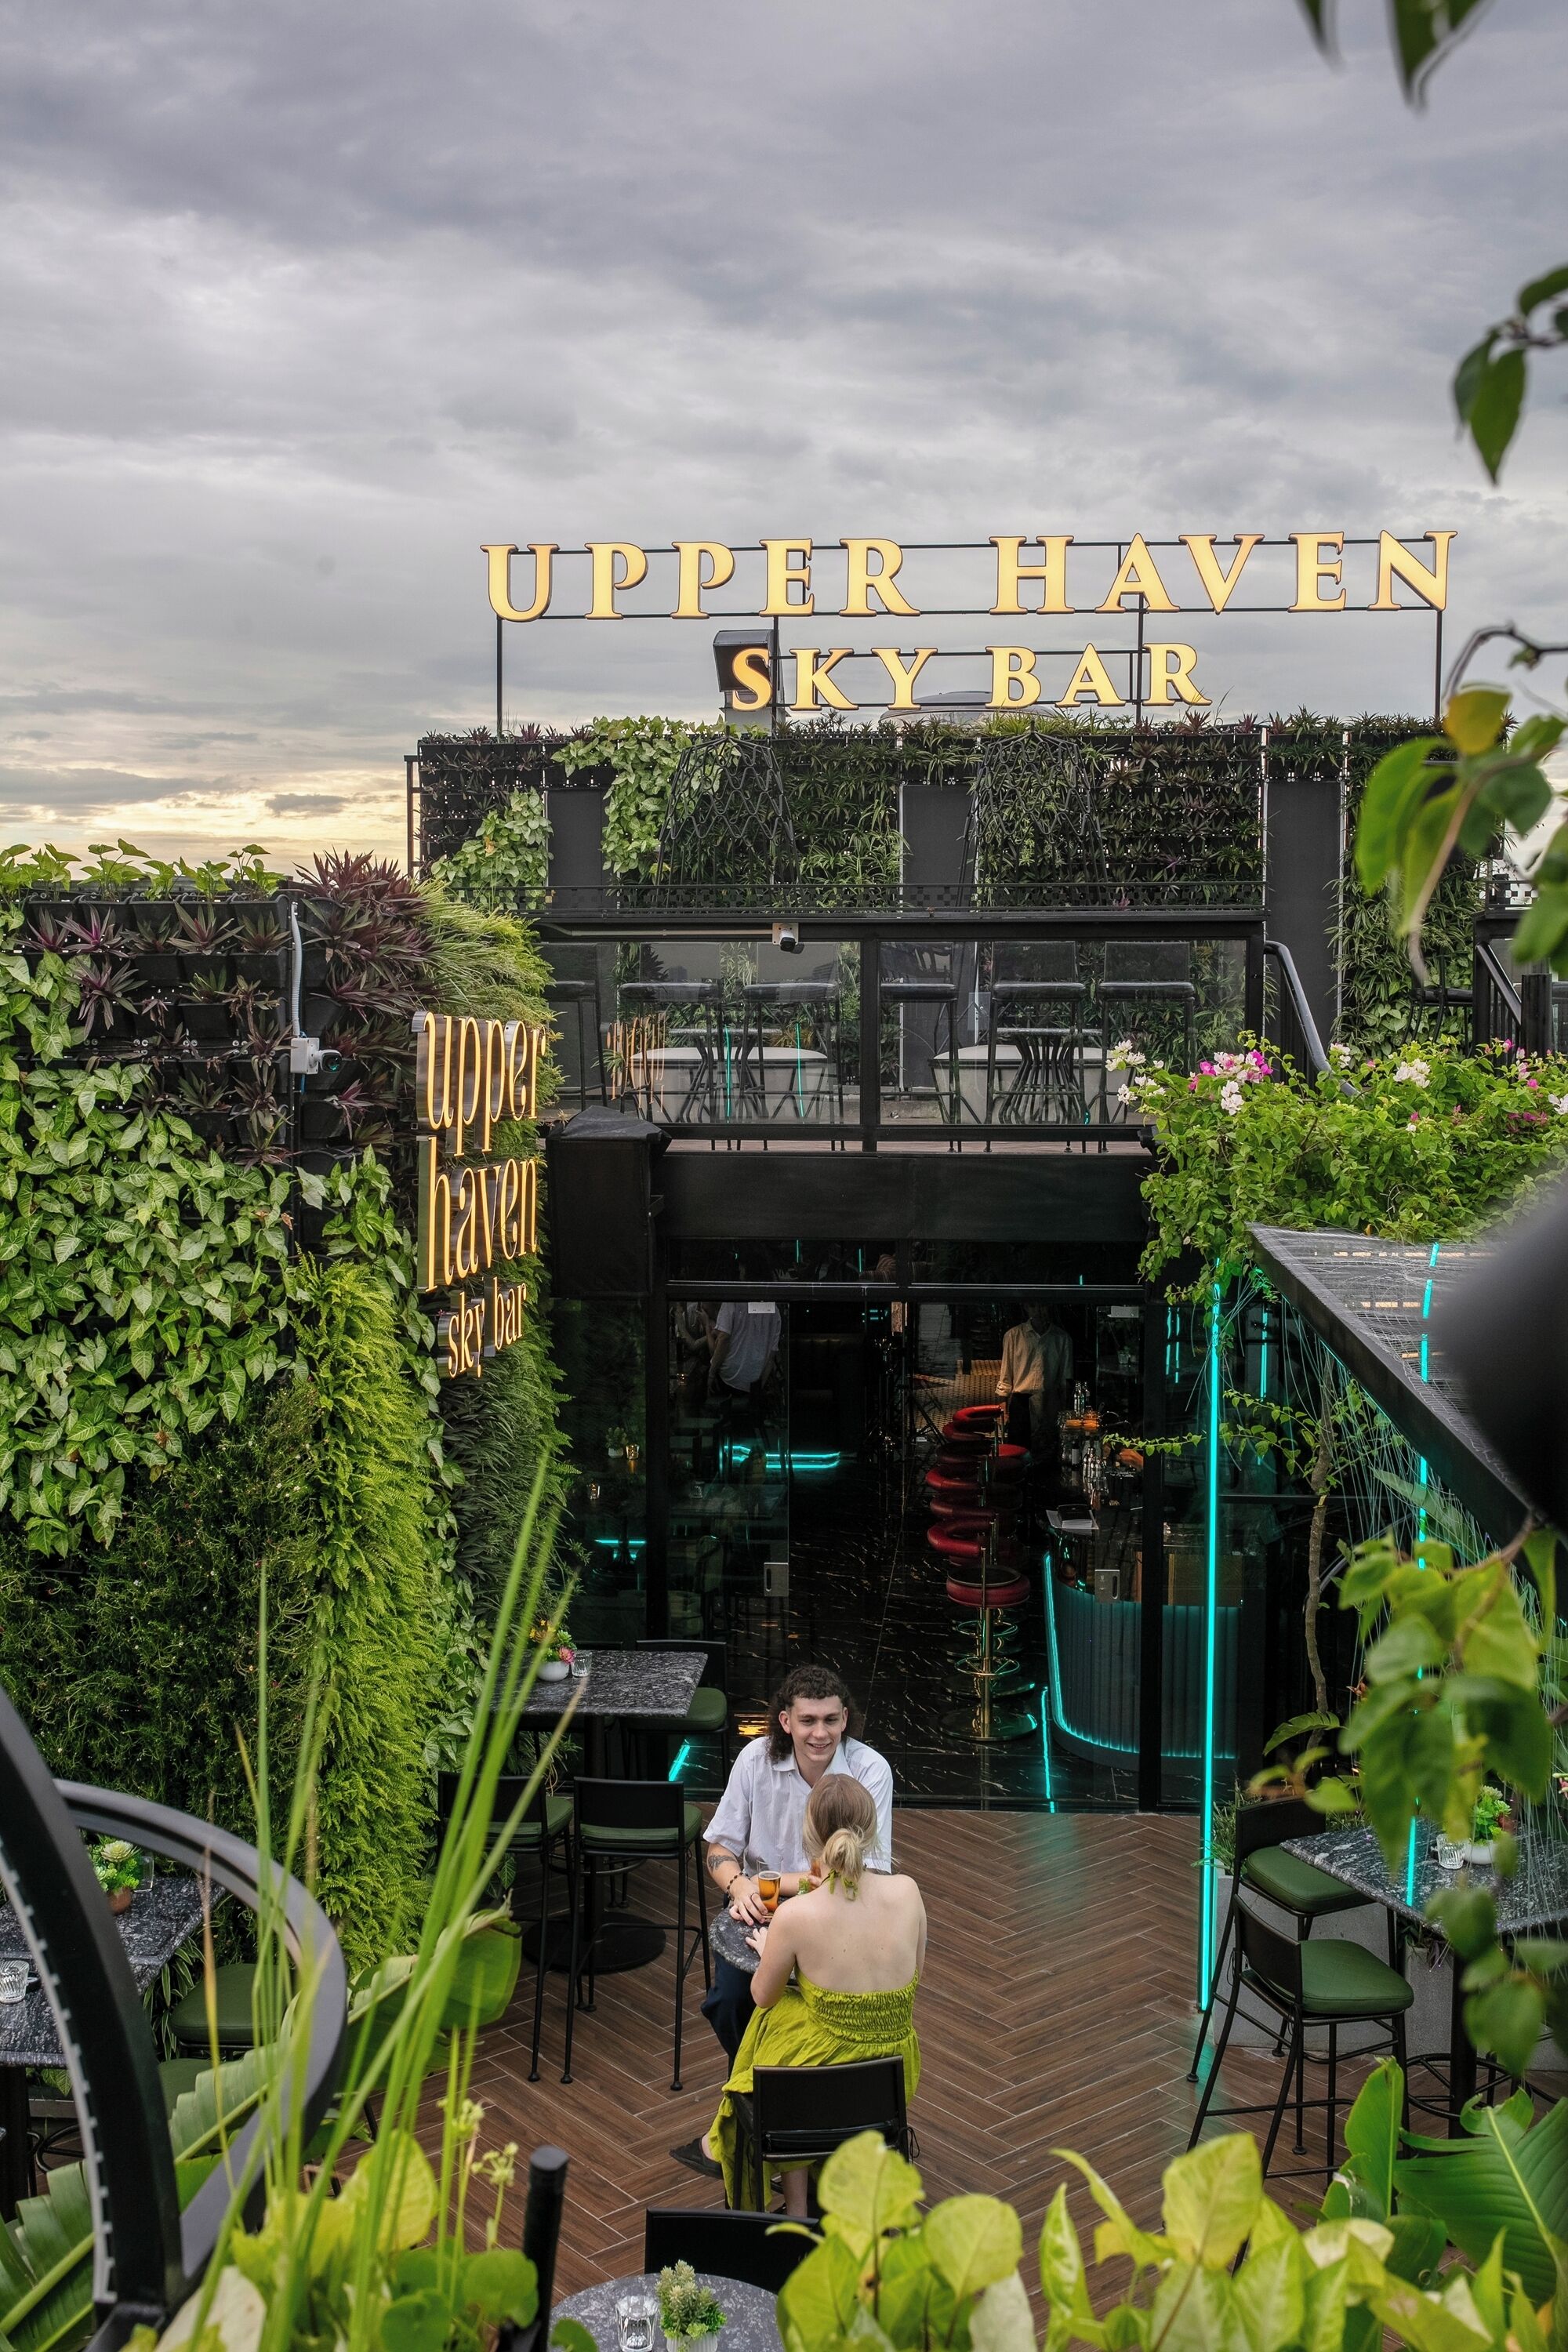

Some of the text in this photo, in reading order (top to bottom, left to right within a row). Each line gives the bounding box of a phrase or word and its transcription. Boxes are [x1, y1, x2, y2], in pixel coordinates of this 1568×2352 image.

[480, 530, 1458, 622] UPPER HAVEN
[731, 643, 1213, 712] SKY BAR
[423, 1011, 546, 1156] upper
[426, 1137, 537, 1292] haven
[448, 1276, 527, 1377] sky bar
